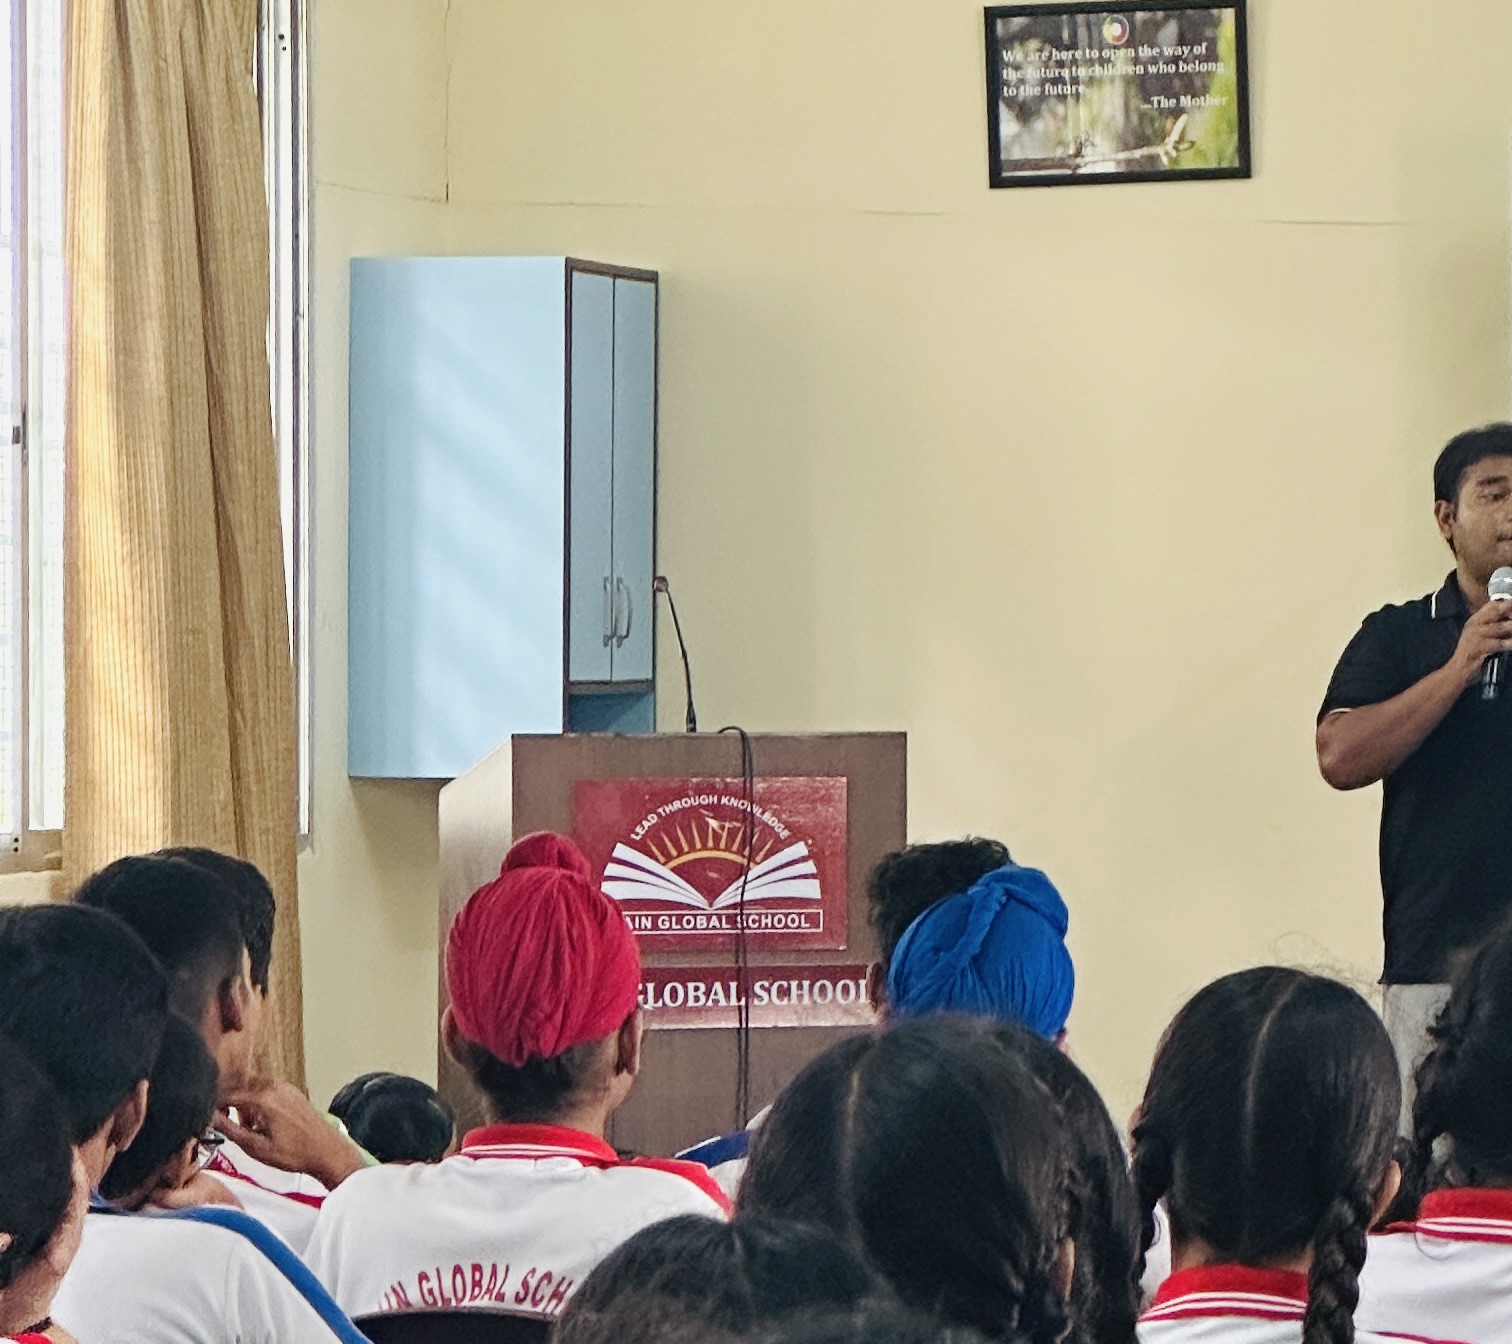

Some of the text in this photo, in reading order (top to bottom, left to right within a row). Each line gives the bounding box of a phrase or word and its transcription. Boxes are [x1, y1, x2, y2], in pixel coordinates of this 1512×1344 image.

[1003, 42, 1208, 63] We are here to open the way of
[1003, 67, 1024, 80] the
[1072, 65, 1086, 76] to
[1088, 62, 1144, 76] children
[1147, 60, 1176, 74] who
[1179, 60, 1225, 74] belong
[1003, 84, 1018, 97] to
[1018, 83, 1041, 96] the
[1179, 93, 1228, 108] Mother
[630, 794, 792, 841] LEAD THROUGH KNOWLEDGE
[625, 913, 810, 930] AIN GLOBAL SCHOOL
[417, 1263, 510, 1308] GLOBAL
[514, 1267, 574, 1316] SCH
